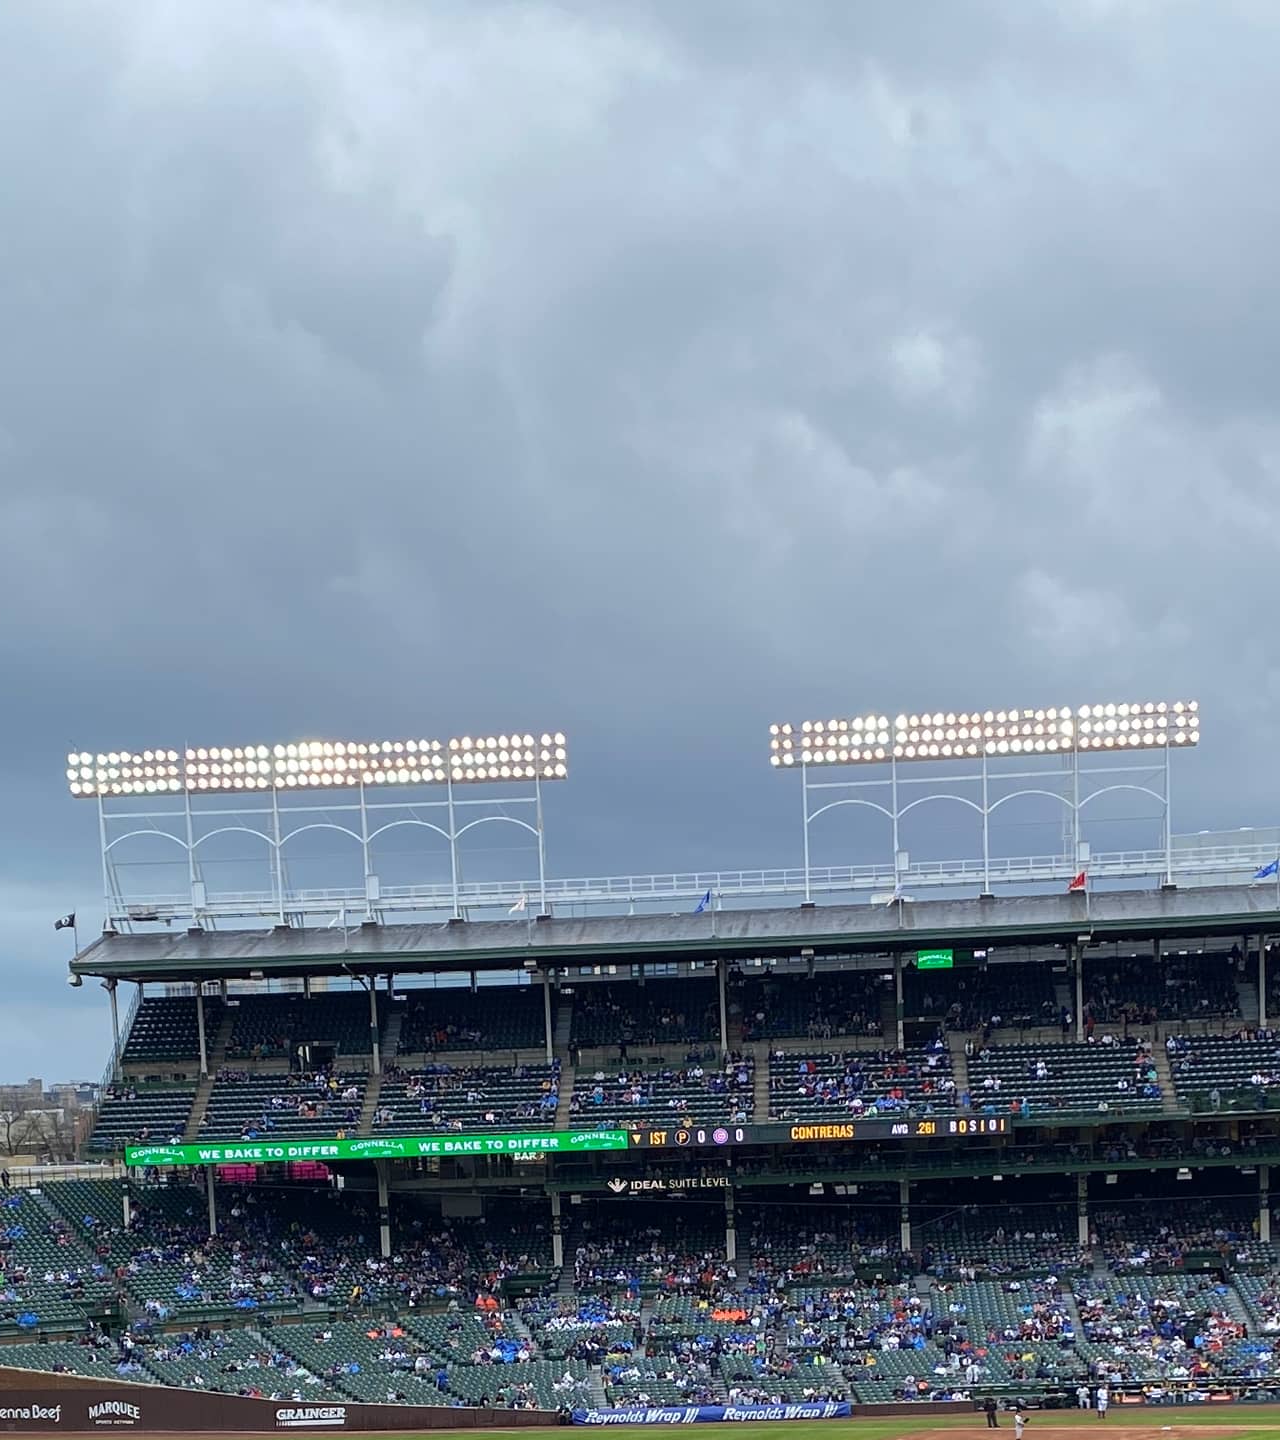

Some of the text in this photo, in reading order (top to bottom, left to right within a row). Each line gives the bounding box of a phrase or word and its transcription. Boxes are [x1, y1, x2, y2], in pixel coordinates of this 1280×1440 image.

[791, 1122, 935, 1140] CONTRERAS AVG .261
[950, 1120, 957, 1132] B
[970, 1120, 977, 1132] S
[350, 1140, 404, 1151] GONNELLA
[418, 1138, 559, 1152] WE BAKE TO DIFFER
[570, 1133, 625, 1144] GONNELLA
[131, 1147, 184, 1159] GONNELLA
[199, 1146, 339, 1160] WE BAKE TO DIFFER
[630, 1177, 732, 1191] IDEAL SUITE LEVEL
[32, 1404, 61, 1422] Beef
[88, 1401, 140, 1419] MARQUEE
[276, 1407, 347, 1420] GRAINGER
[586, 1409, 681, 1425] Reynolds Wrap
[724, 1407, 820, 1422] Reynolds Wrap
